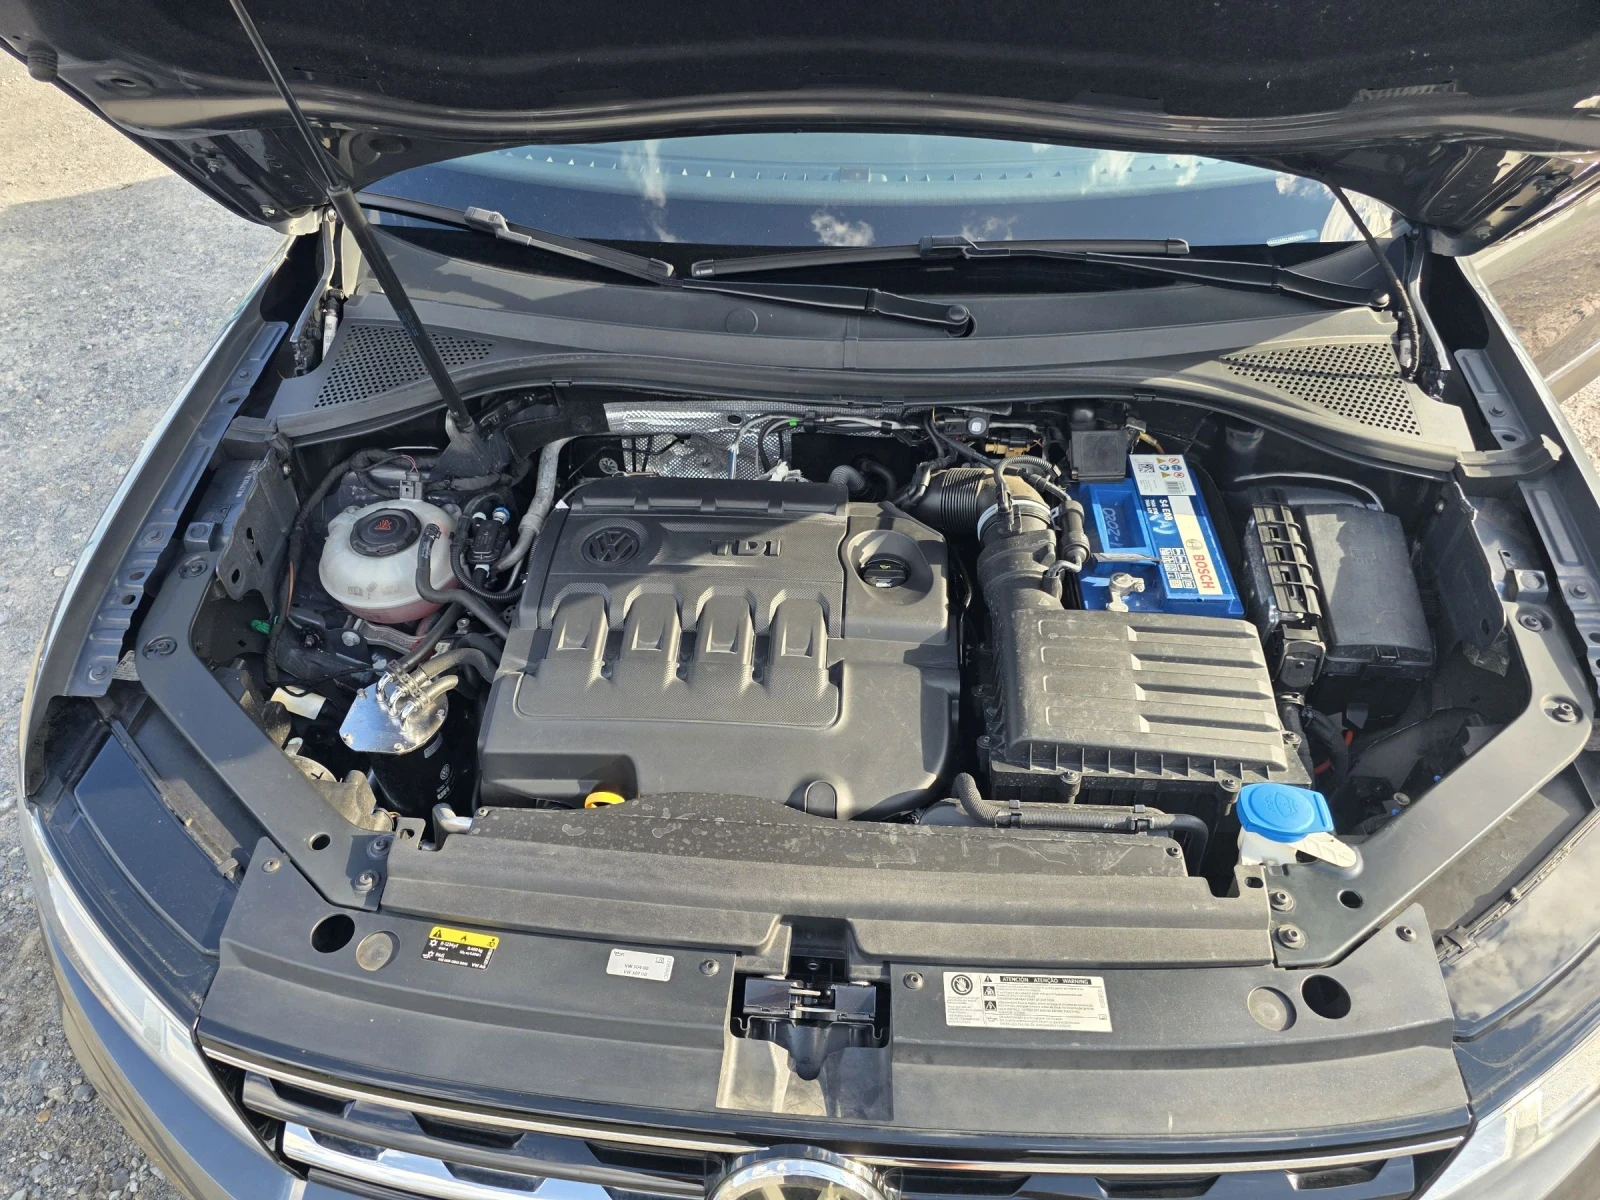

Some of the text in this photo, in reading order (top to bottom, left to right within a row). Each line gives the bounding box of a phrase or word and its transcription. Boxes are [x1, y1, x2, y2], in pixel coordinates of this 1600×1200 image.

[1159, 499, 1169, 508] S4
[709, 539, 782, 557] TDI
[1193, 554, 1215, 589] BOSCH
